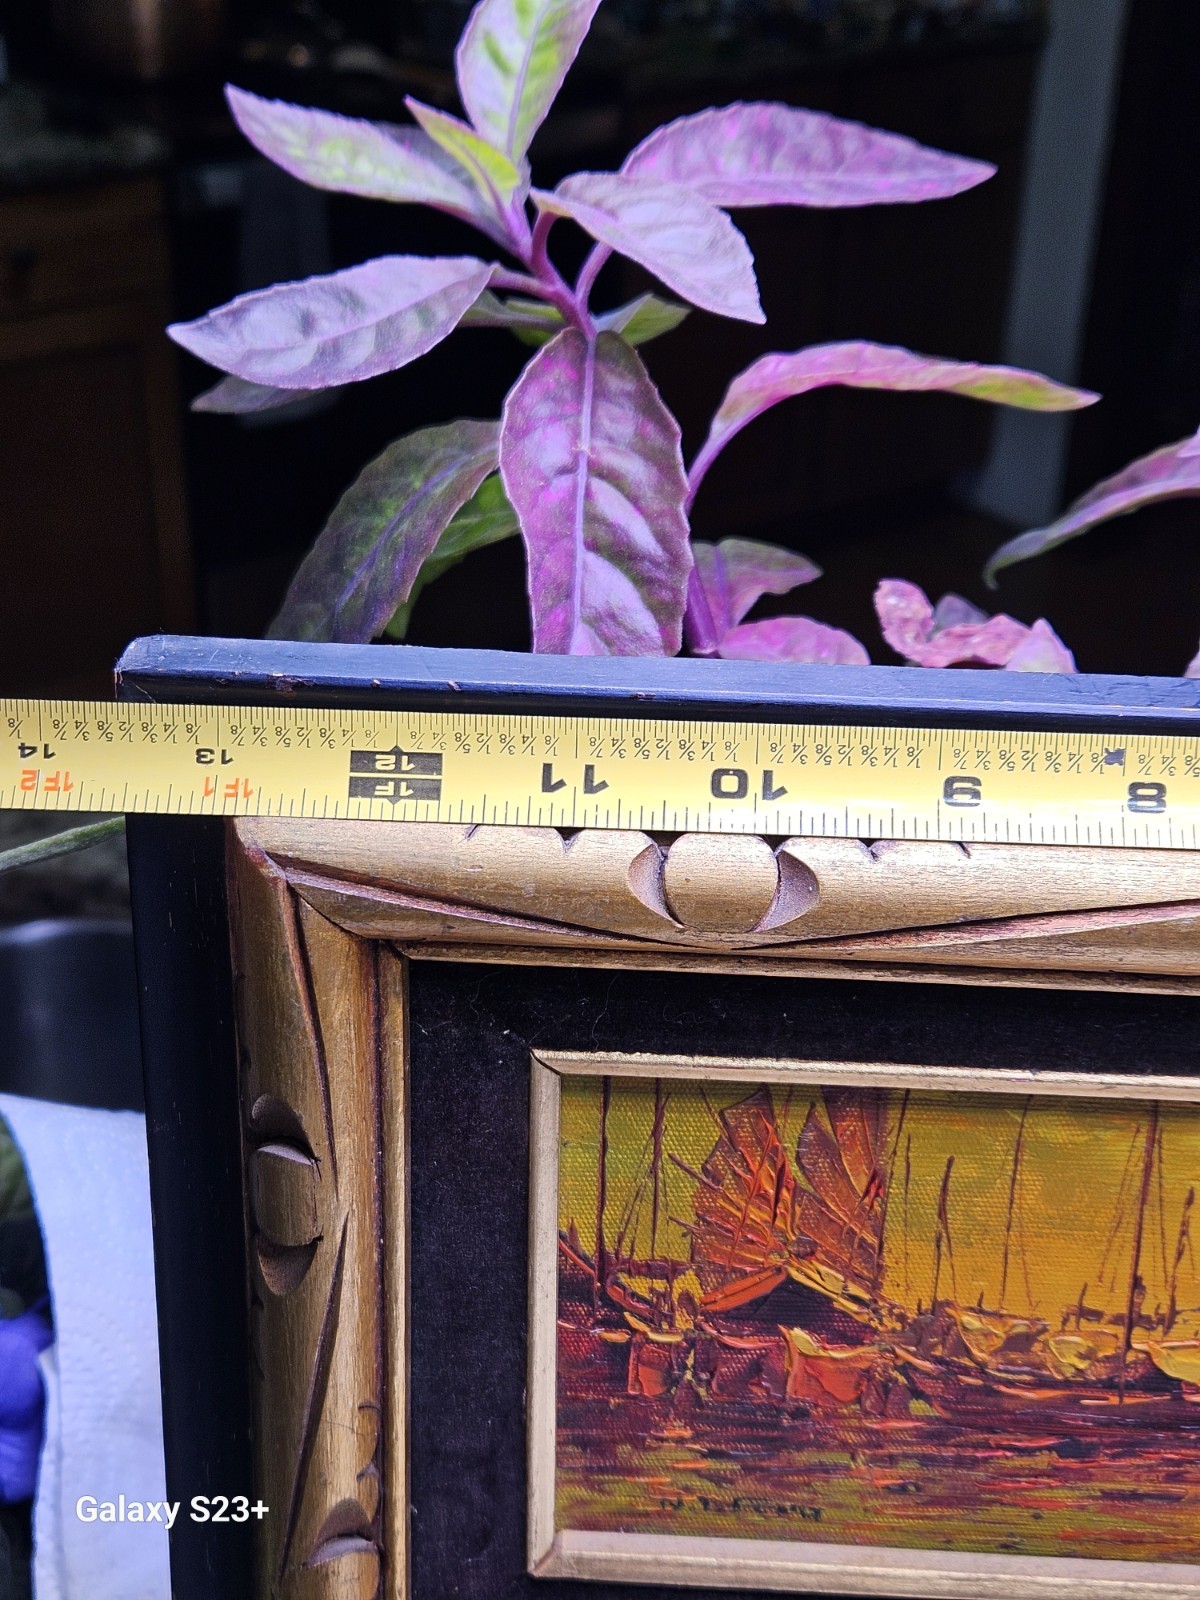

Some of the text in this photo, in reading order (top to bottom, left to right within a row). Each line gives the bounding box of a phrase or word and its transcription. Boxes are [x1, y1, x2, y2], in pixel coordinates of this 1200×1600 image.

[18, 742, 1166, 813] 8 9 10 11 12 13 14
[374, 781, 414, 797] 1F
